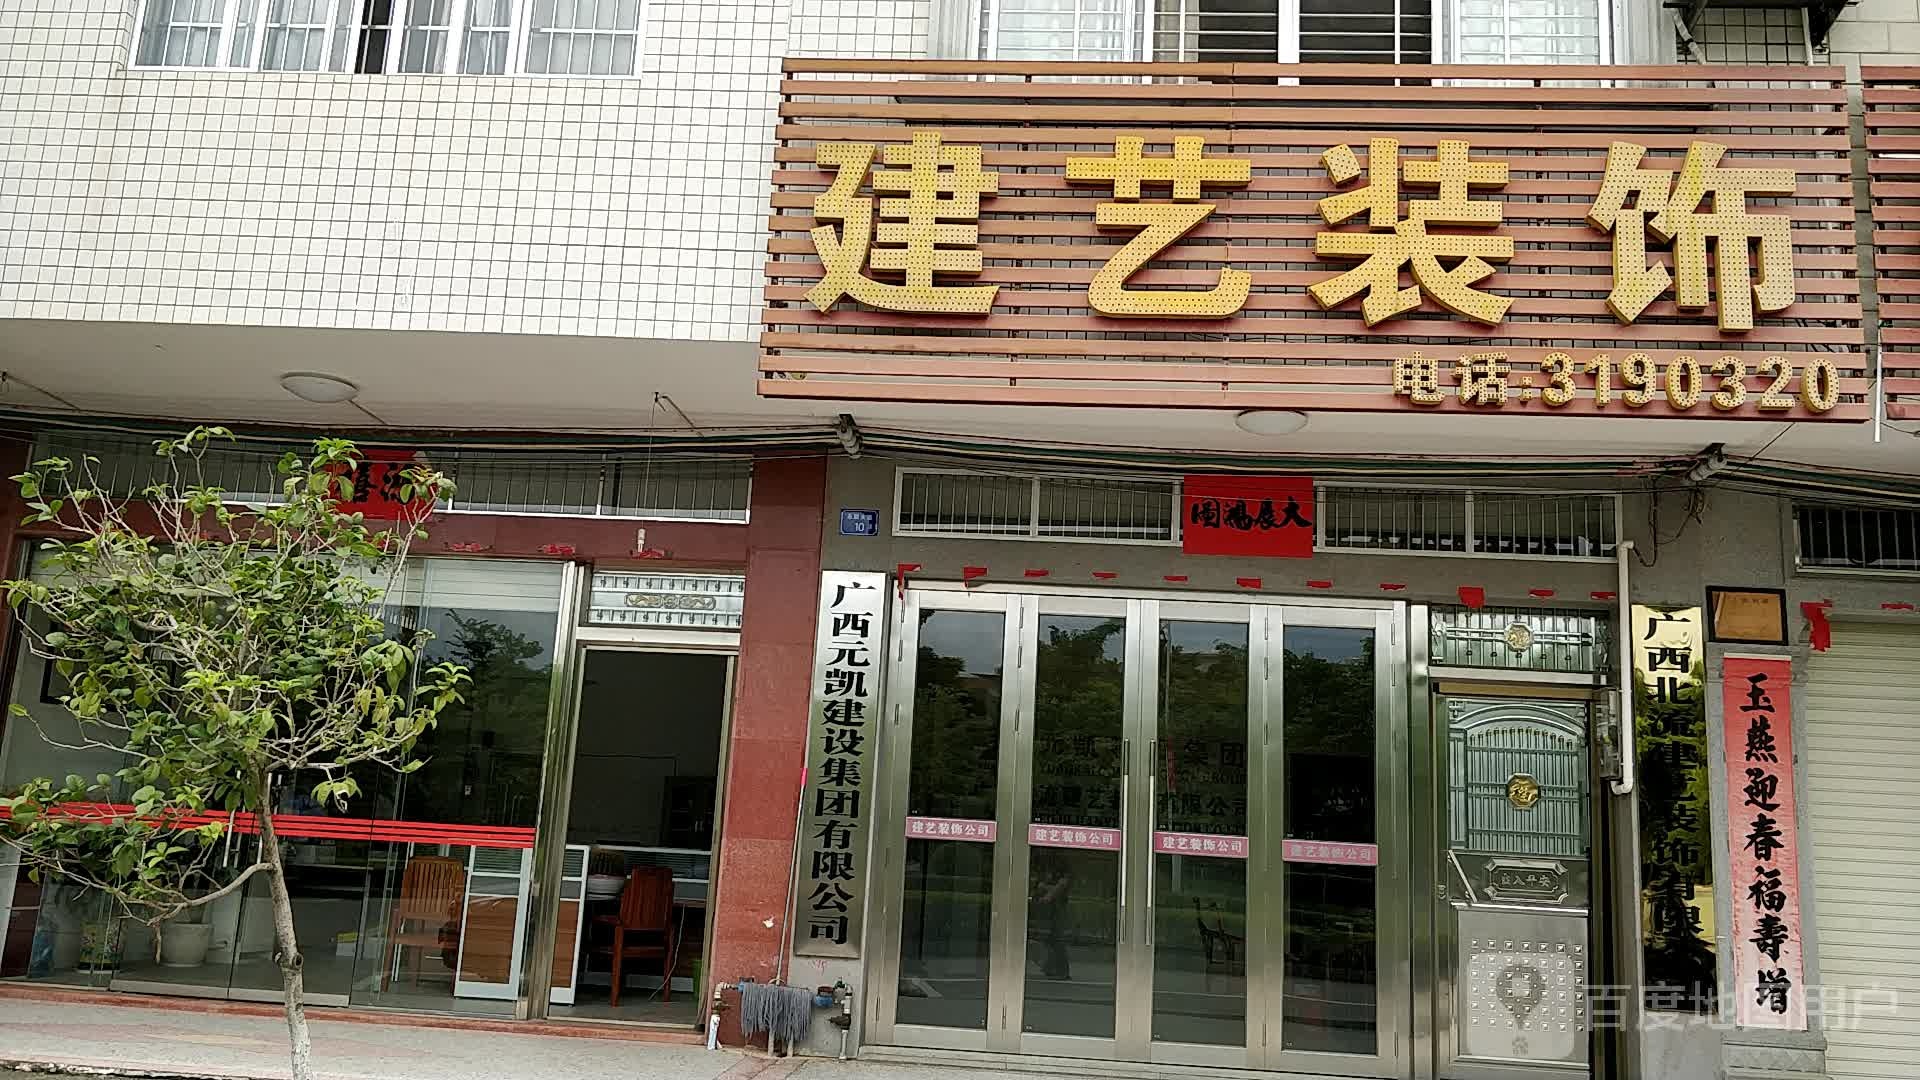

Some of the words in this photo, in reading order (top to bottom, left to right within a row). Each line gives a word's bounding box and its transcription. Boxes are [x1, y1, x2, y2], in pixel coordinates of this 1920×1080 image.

[804, 131, 1797, 333] 建艺装饰
[807, 582, 876, 945] 广西元凯建设集团有限公司
[911, 821, 990, 838] 建艺装饰公司
[1034, 828, 1114, 847] 建艺装饰公司
[1162, 836, 1243, 853] 建艺装饰公司
[1291, 844, 1371, 861] 建艺装饰公司
